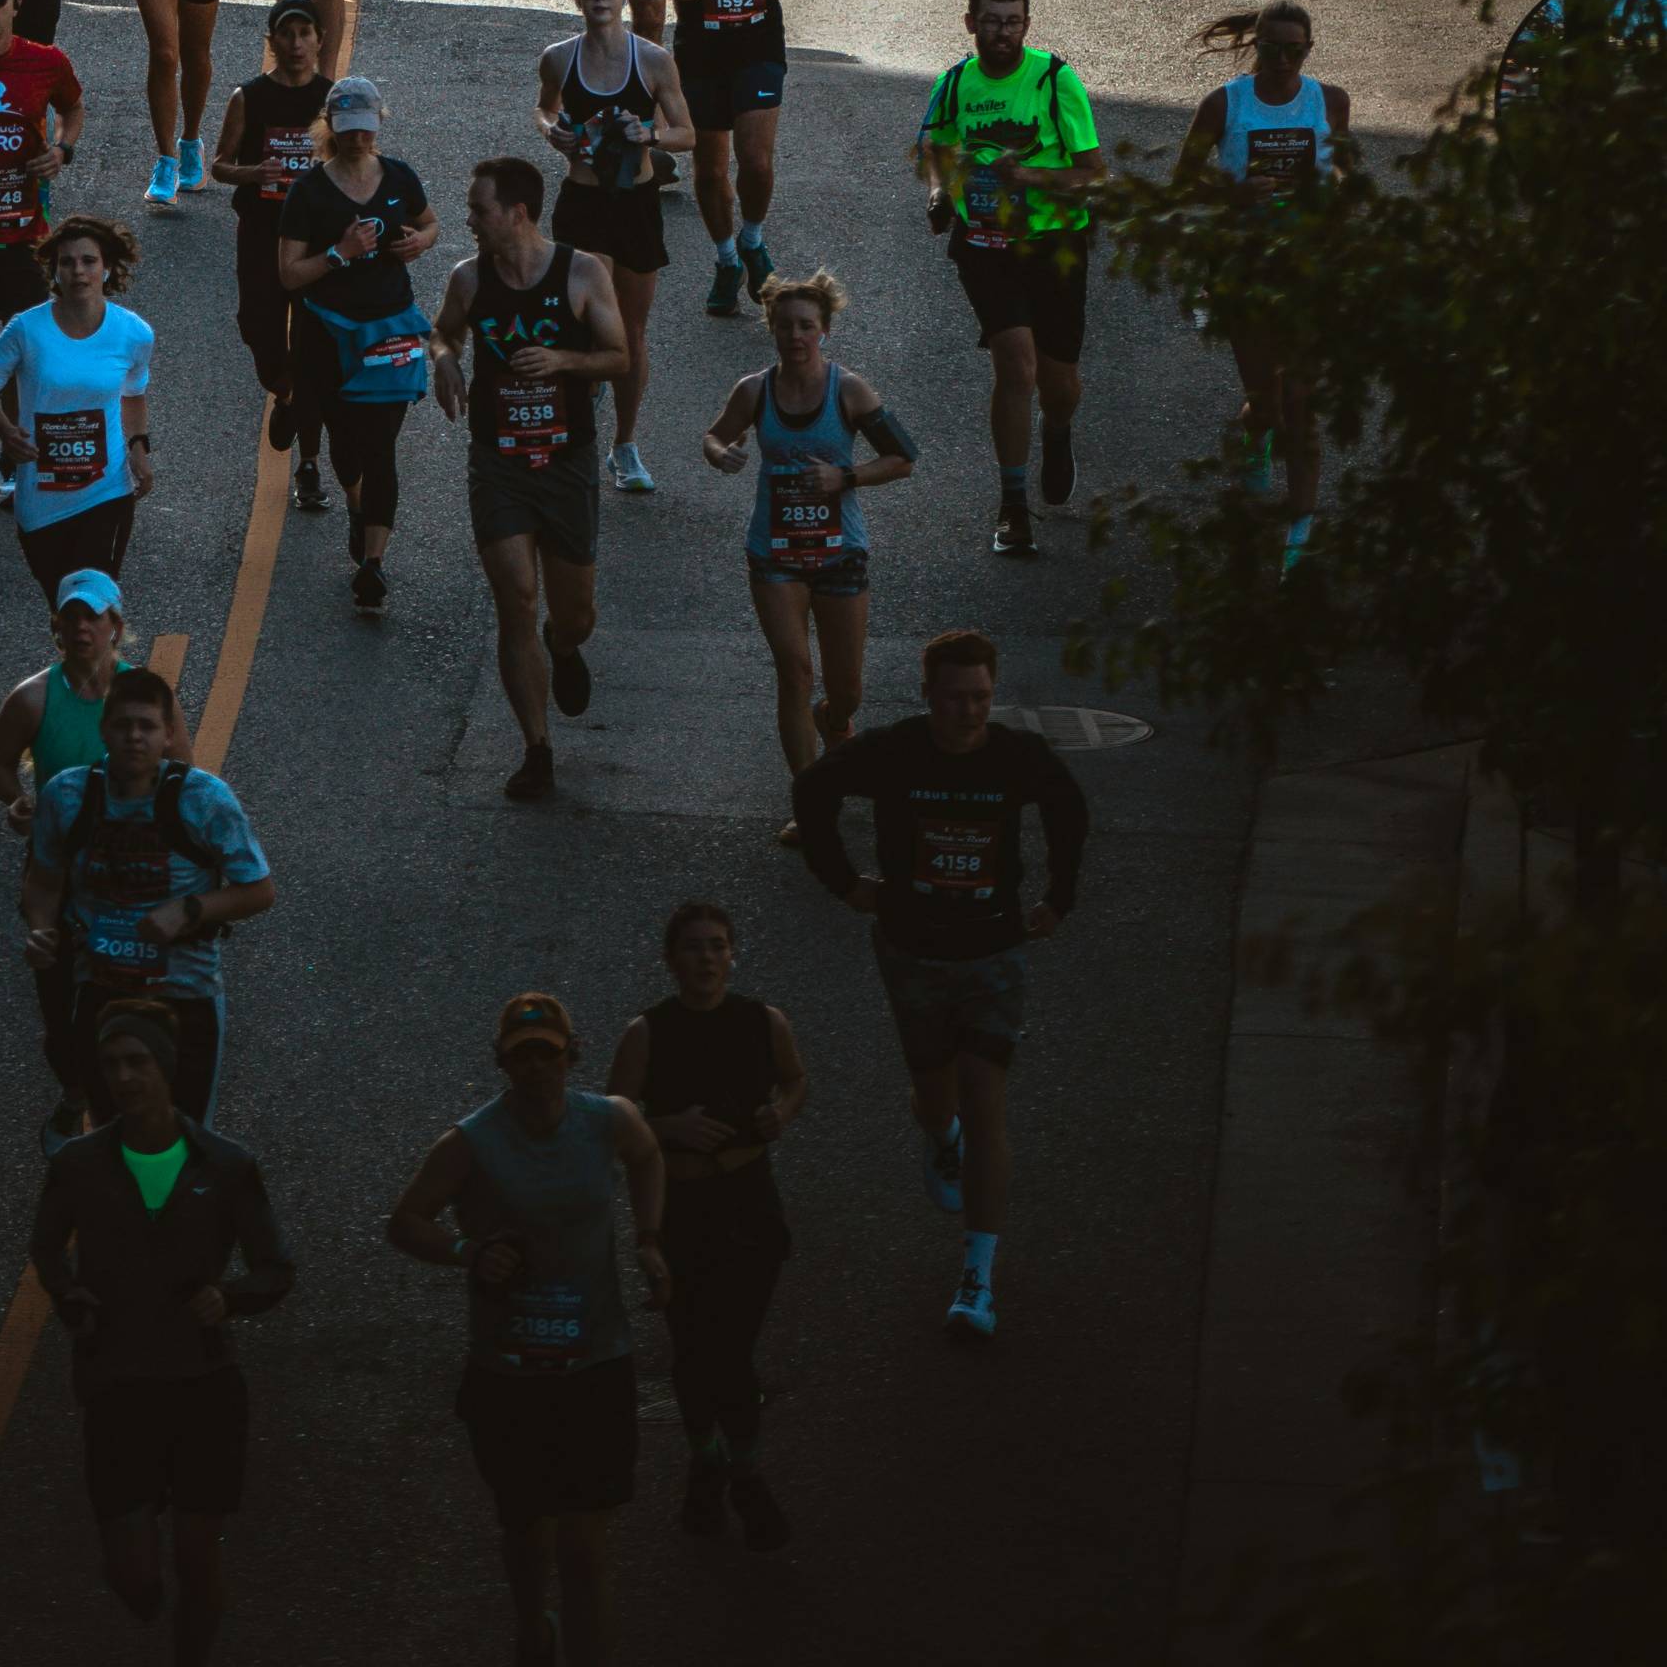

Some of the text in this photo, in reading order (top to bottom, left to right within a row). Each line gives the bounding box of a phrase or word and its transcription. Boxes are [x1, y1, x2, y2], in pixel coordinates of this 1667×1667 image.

[508, 404, 554, 422] 2638
[48, 440, 96, 456] 2065
[782, 505, 829, 522] 2830
[910, 789, 950, 800] JESUS
[973, 794, 1005, 802] KING
[931, 855, 981, 870] 4158
[95, 937, 158, 959] 20815
[510, 1318, 580, 1338] 21866
